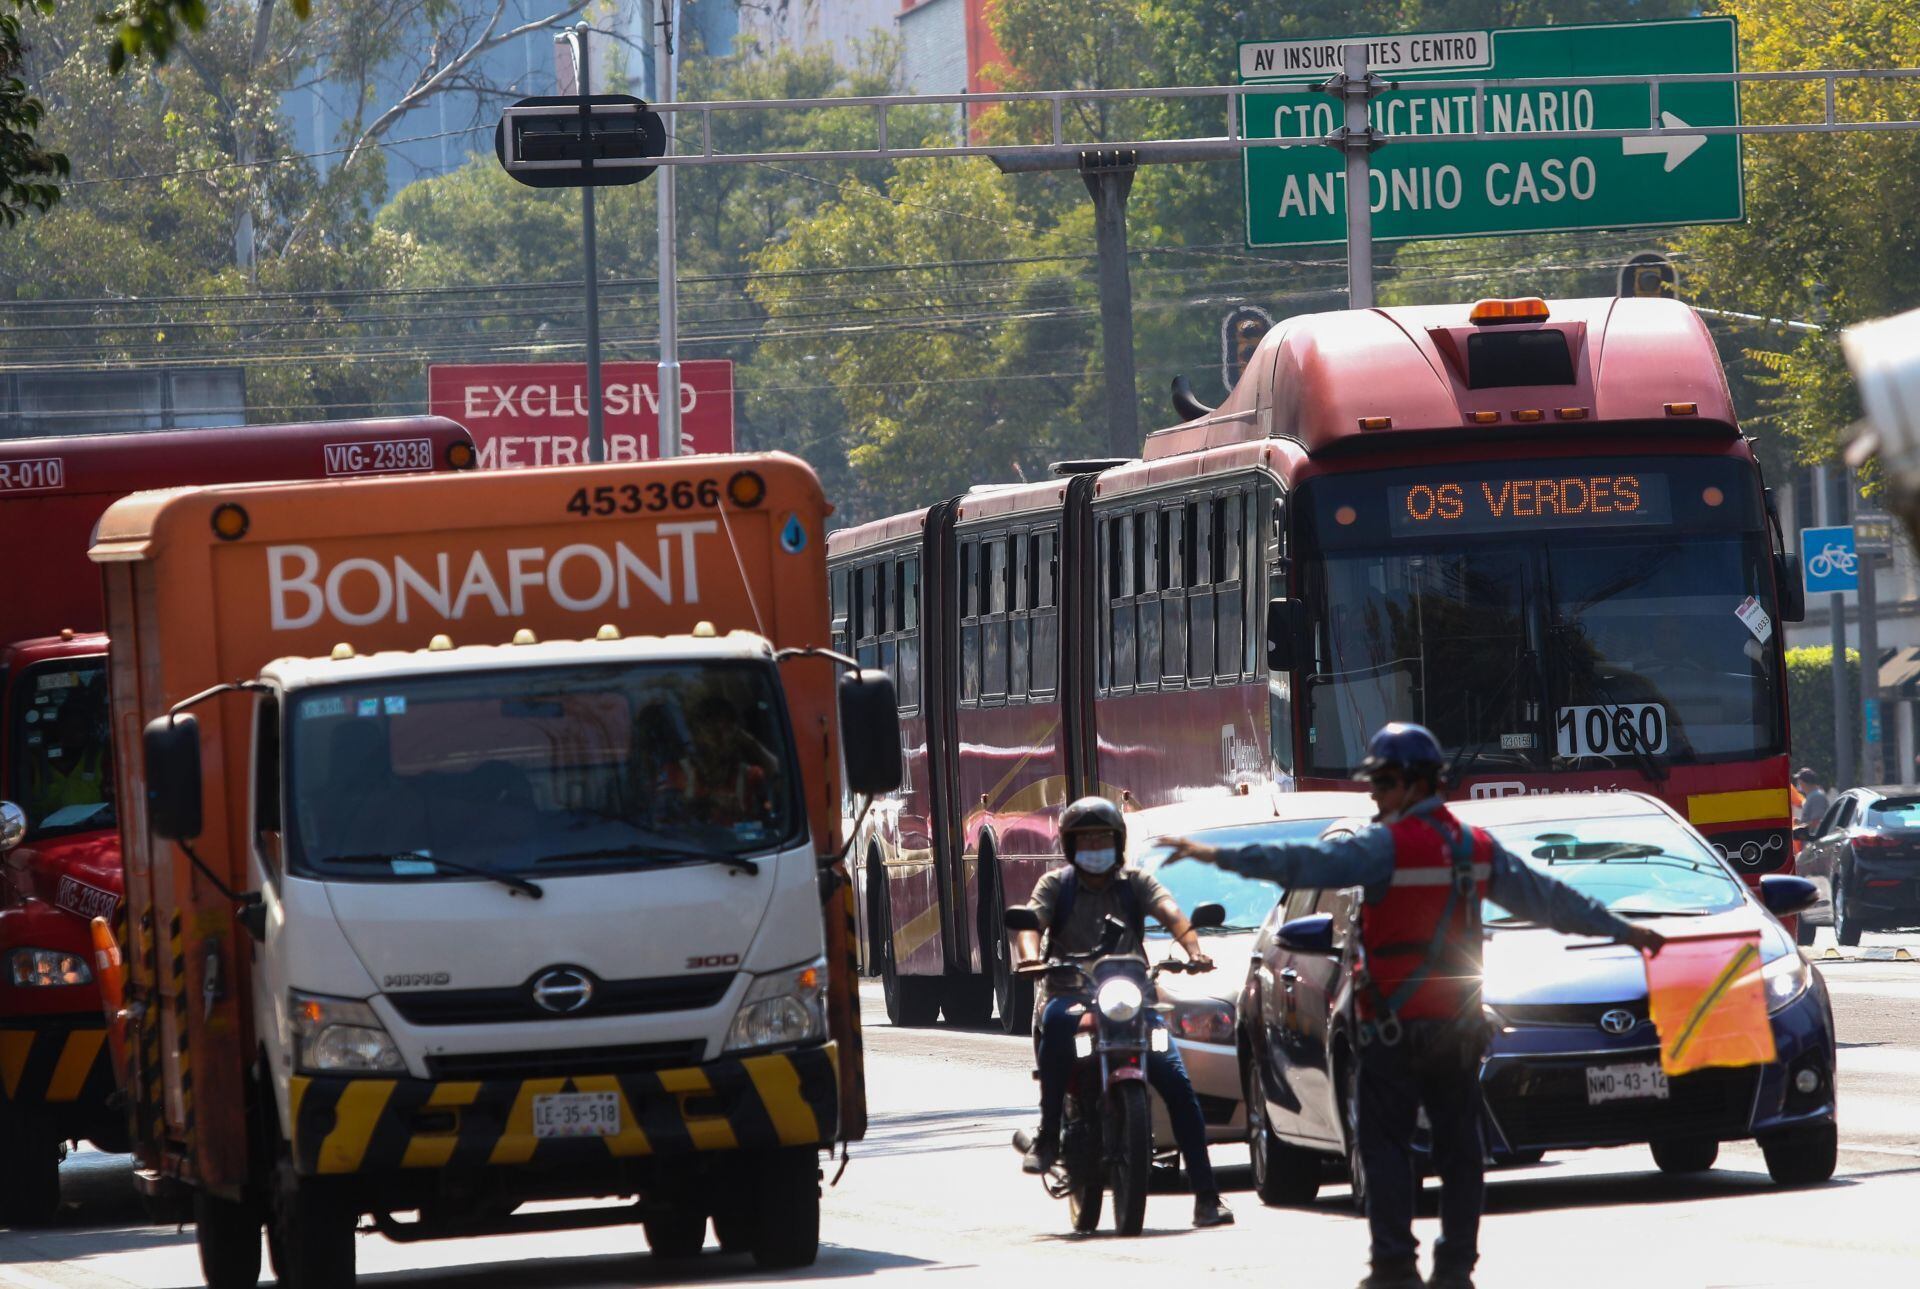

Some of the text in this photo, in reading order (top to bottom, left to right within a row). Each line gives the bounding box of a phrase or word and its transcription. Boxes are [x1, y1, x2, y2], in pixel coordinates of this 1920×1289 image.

[1254, 36, 1478, 72] AV INSURTES CENTRO
[1274, 88, 1595, 150] CTO ICENTNARIO
[1485, 155, 1597, 208] CASO
[566, 477, 720, 517] 453366
[1406, 475, 1641, 520] OS VERDES
[266, 519, 717, 631] BONAFONT
[1754, 615, 1770, 634] 1033
[1557, 705, 1664, 754] 1060
[686, 954, 738, 969] 300
